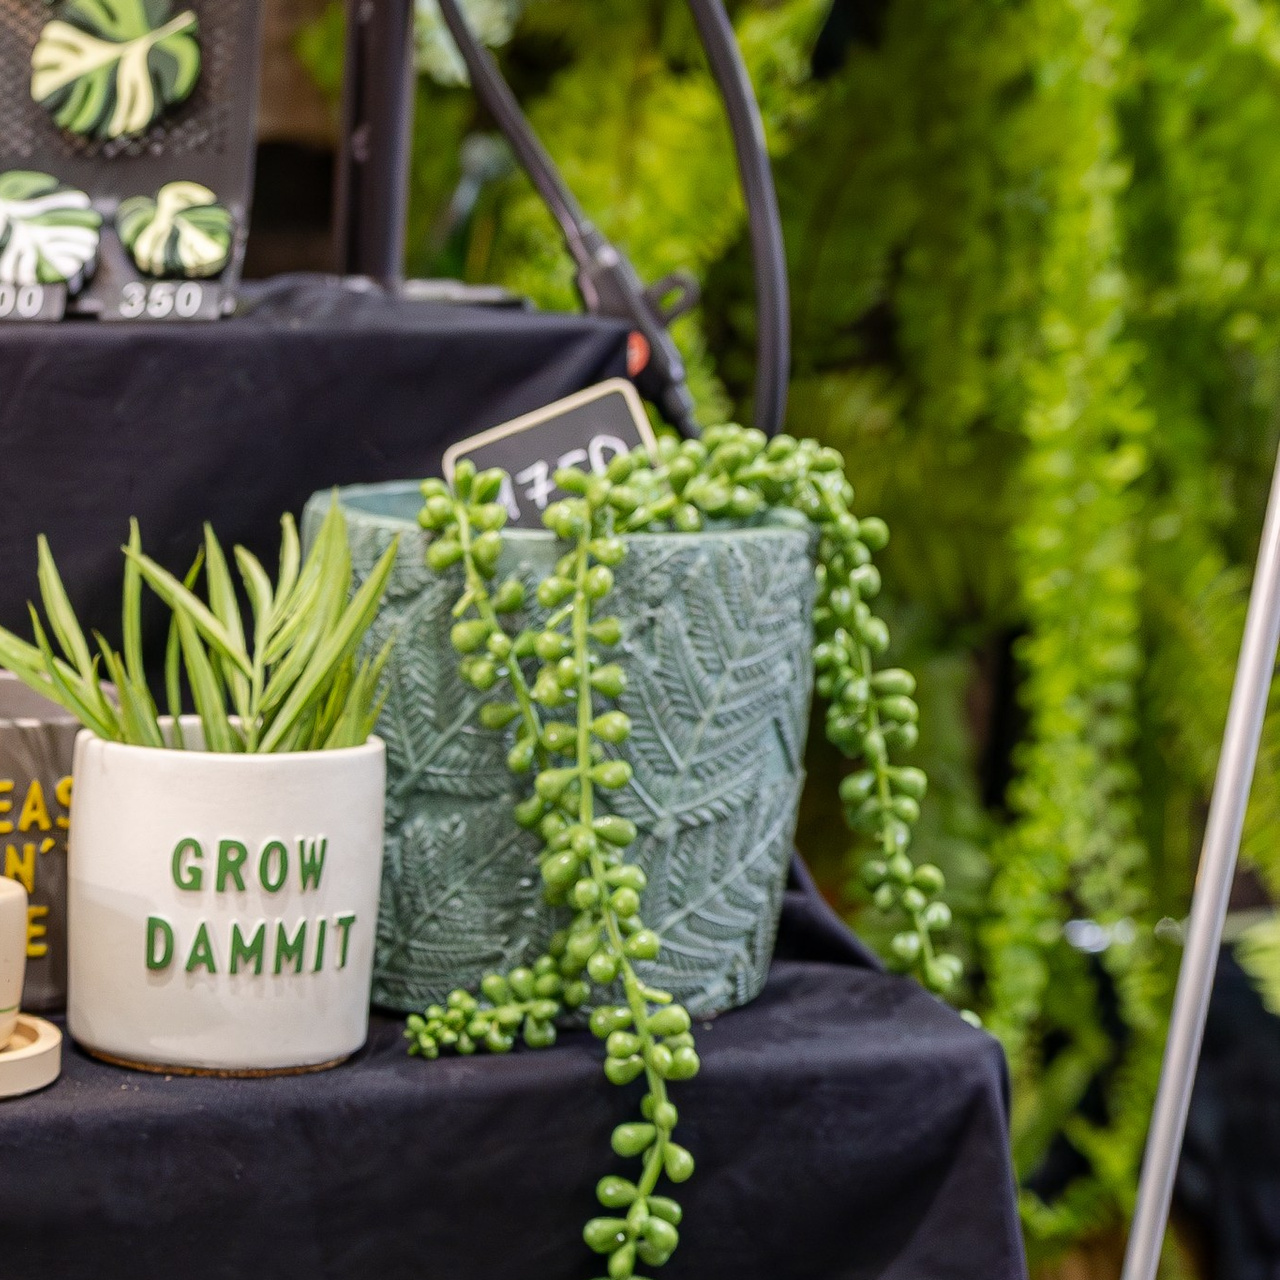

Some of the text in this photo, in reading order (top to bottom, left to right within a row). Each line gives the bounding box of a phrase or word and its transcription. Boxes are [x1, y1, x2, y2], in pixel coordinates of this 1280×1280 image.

[120, 280, 204, 318] 350
[172, 836, 327, 893] GROW
[146, 911, 356, 975] DAMMIT
